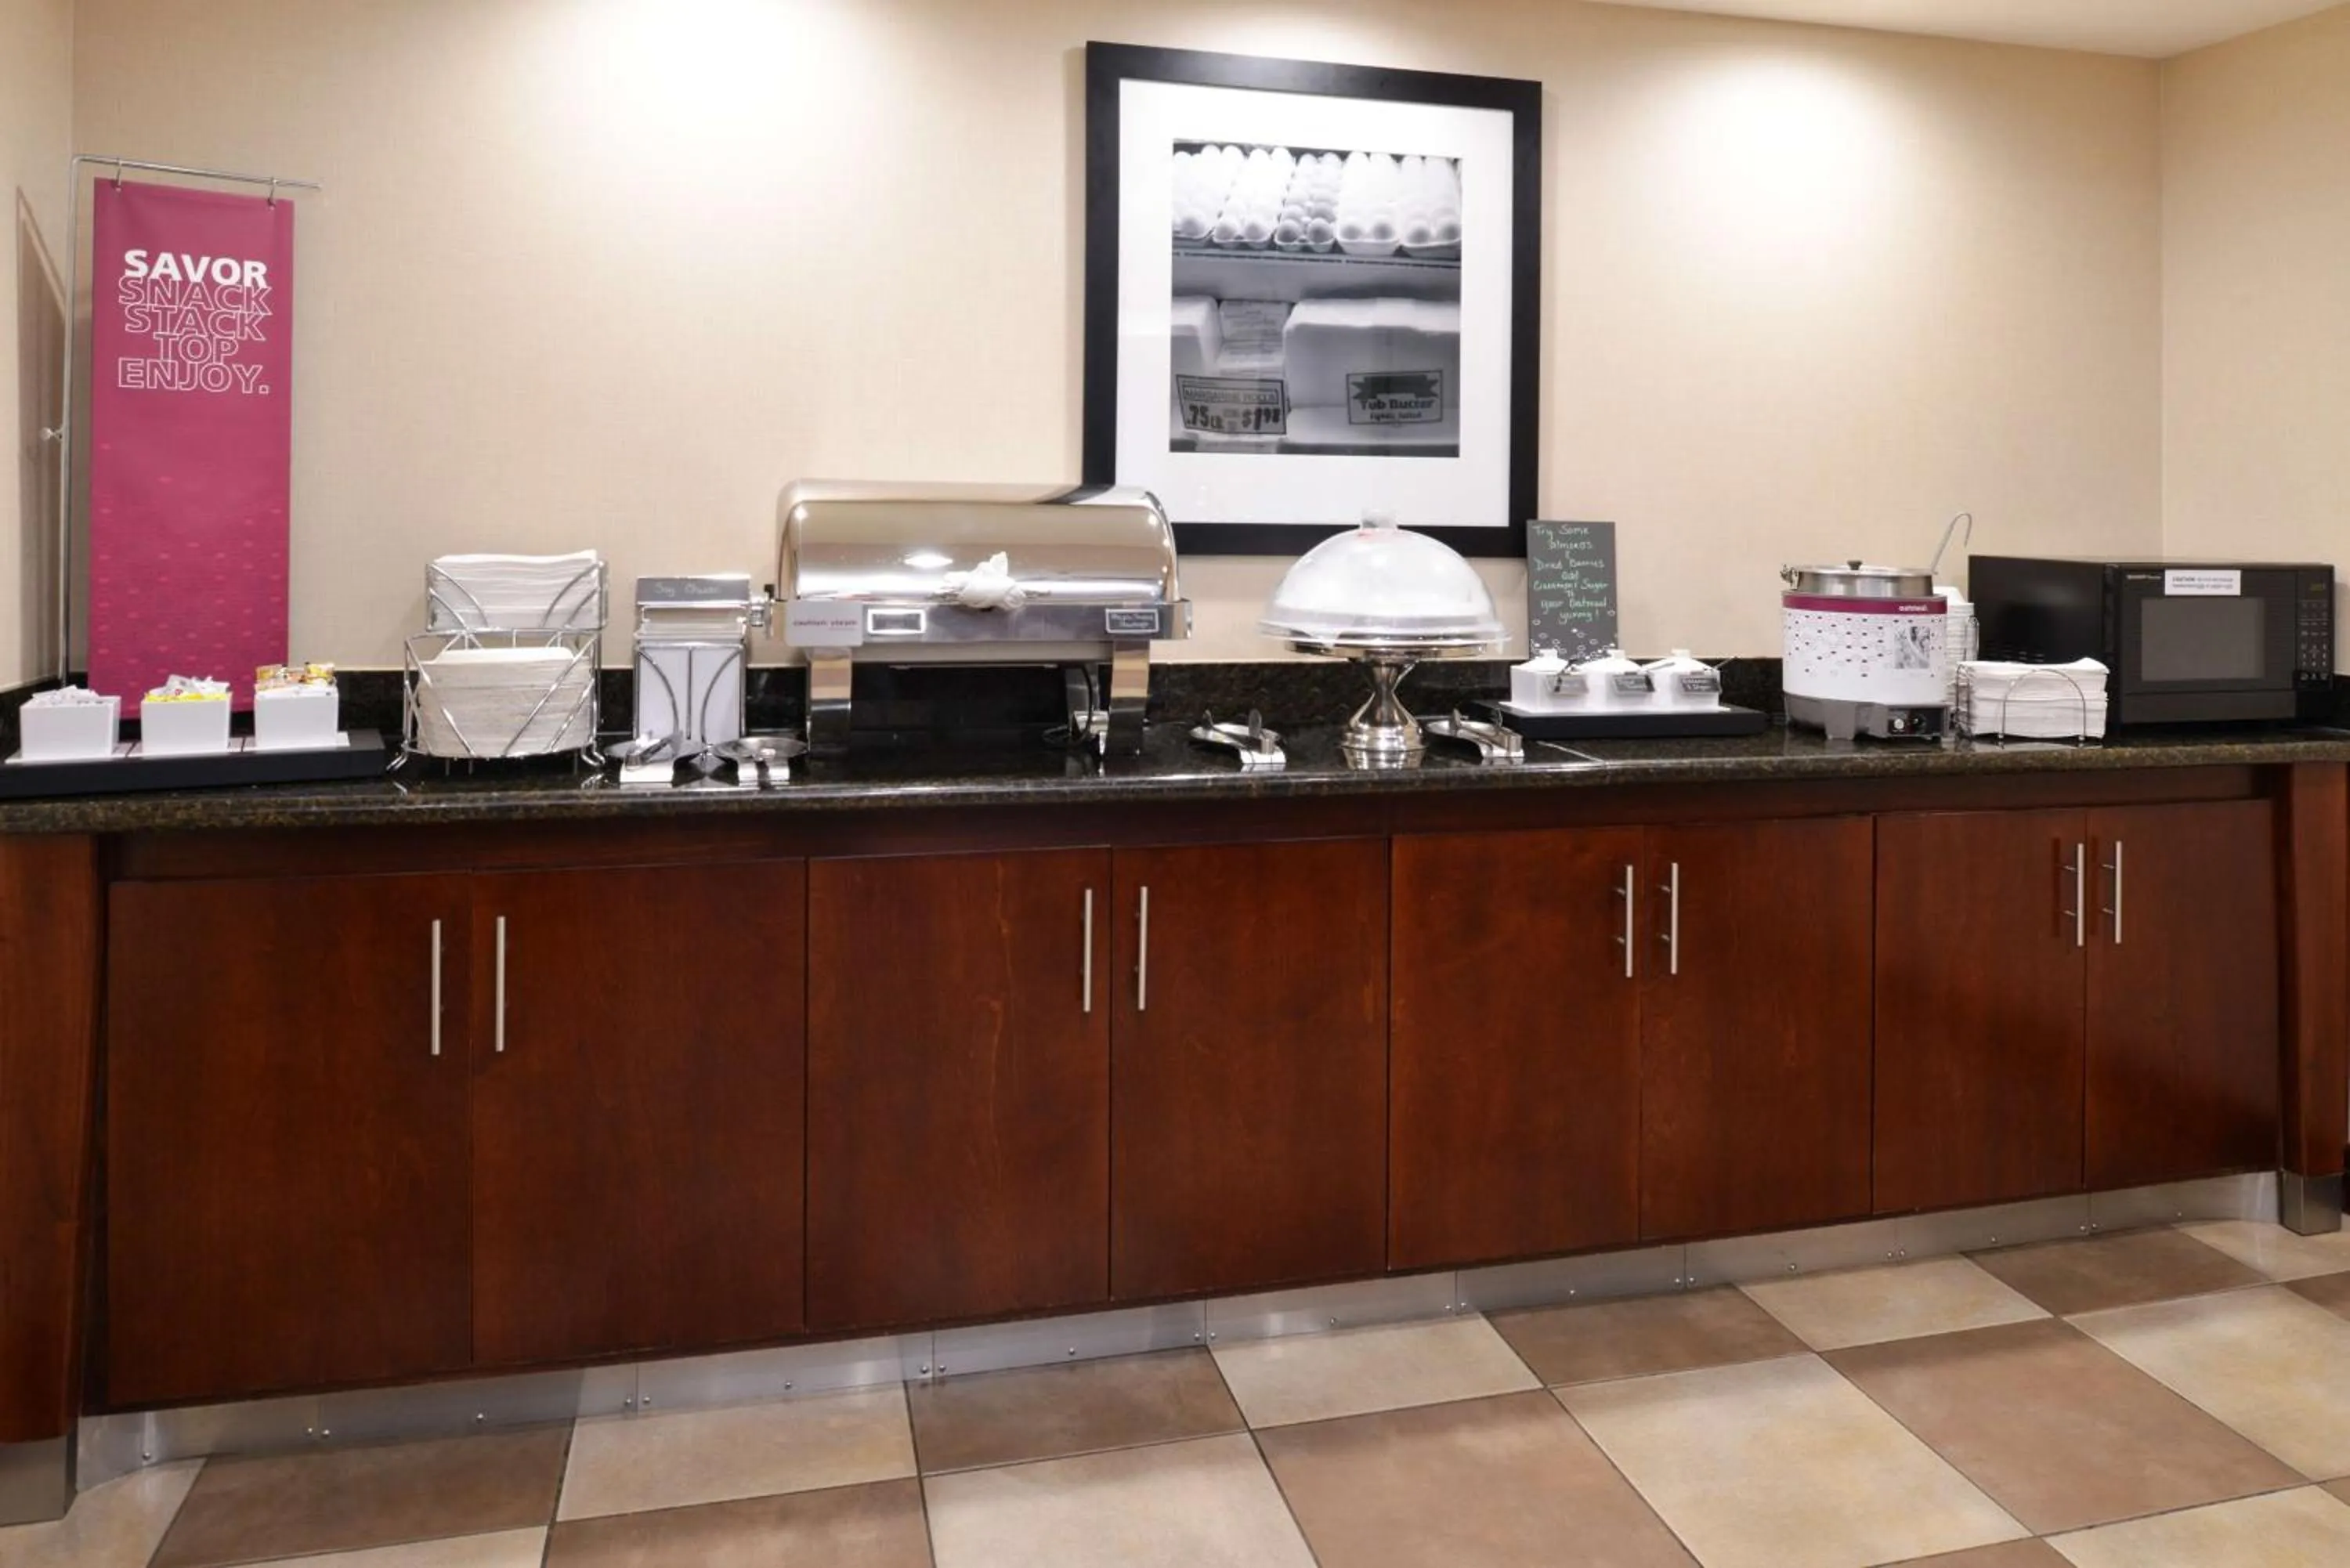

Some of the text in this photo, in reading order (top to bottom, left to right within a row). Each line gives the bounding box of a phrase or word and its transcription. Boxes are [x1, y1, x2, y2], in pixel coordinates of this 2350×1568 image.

[124, 249, 268, 289] SAVOR
[118, 276, 273, 316] SNACK
[125, 303, 266, 341] STACK
[154, 332, 239, 365] TOP
[118, 357, 270, 394] ENJOY.
[1532, 524, 1553, 541] Try
